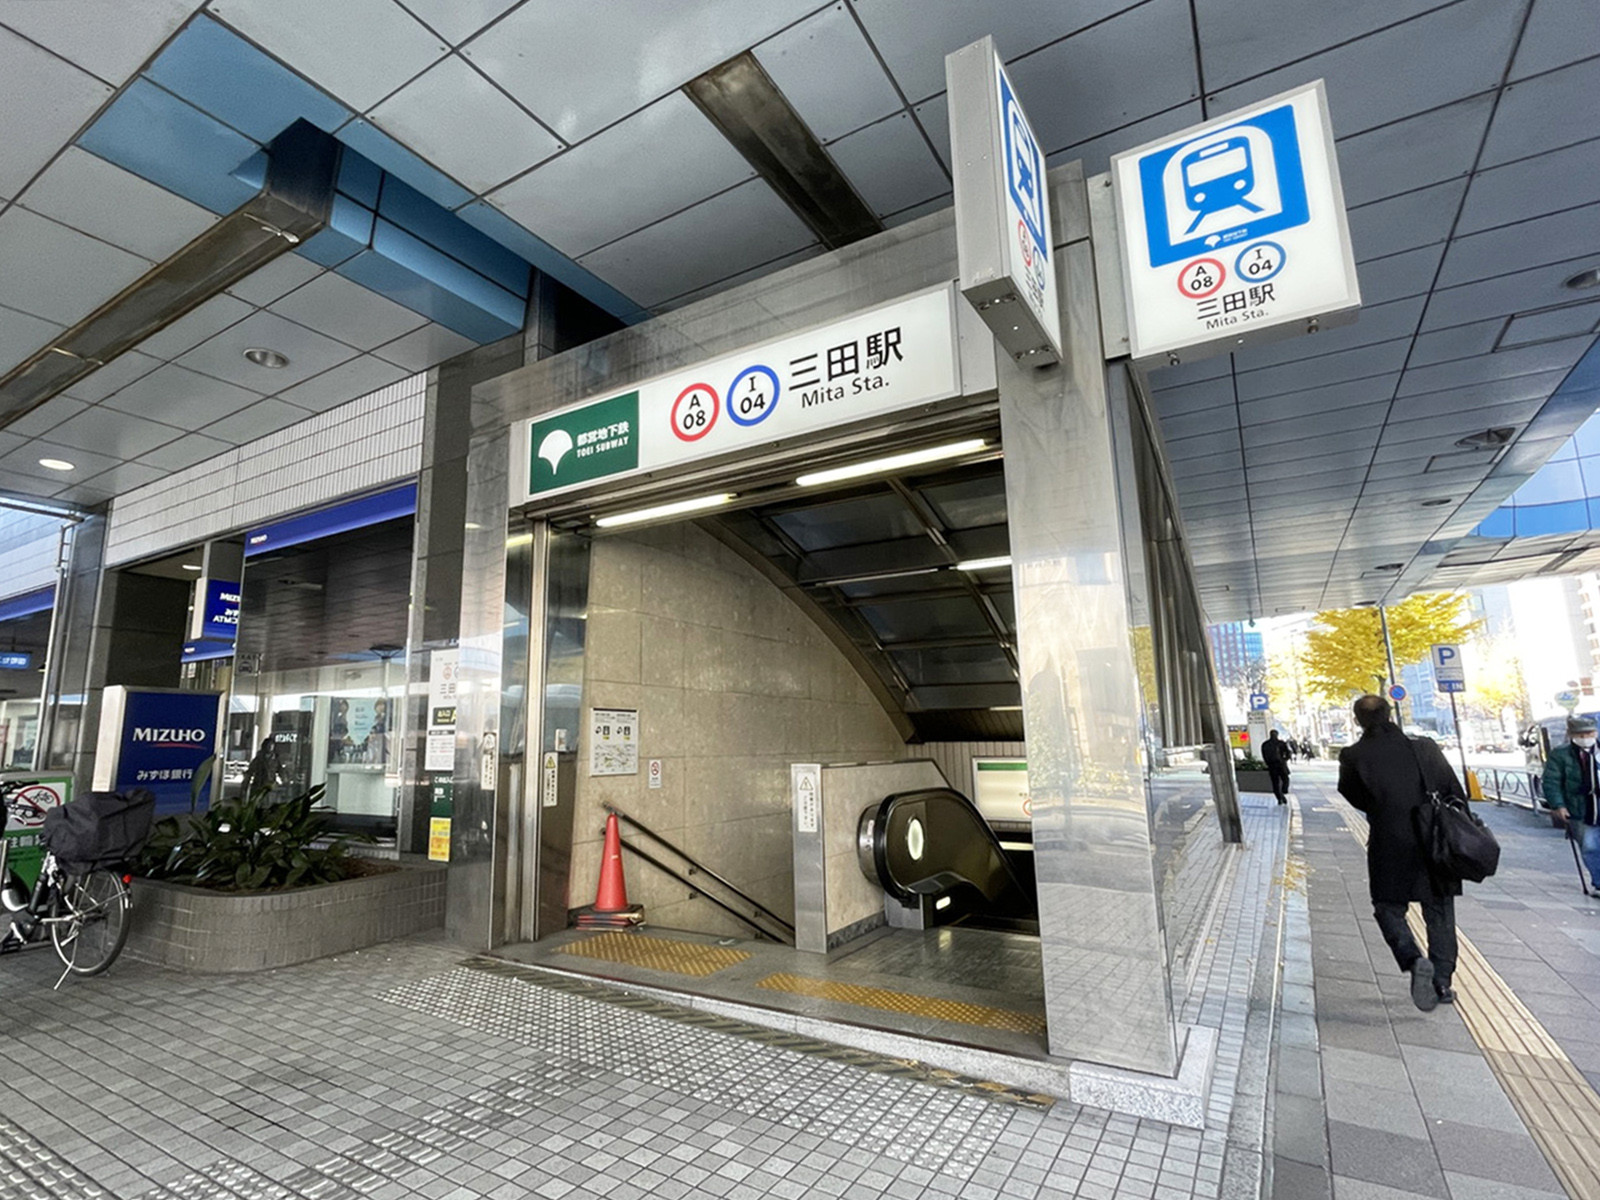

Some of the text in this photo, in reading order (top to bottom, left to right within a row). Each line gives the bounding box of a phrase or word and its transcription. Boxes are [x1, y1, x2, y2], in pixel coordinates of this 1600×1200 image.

[1256, 248, 1263, 260] I
[1195, 265, 1207, 277] A
[1248, 259, 1273, 275] 04
[1190, 276, 1214, 291] 08
[1196, 283, 1276, 320] 三田駅
[1206, 309, 1269, 330] Mita Sta.
[788, 326, 904, 391] 三田駅
[749, 376, 756, 392] I
[801, 375, 890, 408] Mita Sta.
[689, 394, 701, 410] A
[740, 393, 766, 414] 04
[683, 410, 706, 430] 08
[1438, 647, 1455, 666] P
[1252, 696, 1267, 709] P
[133, 727, 206, 742] MIZUHO
[136, 769, 193, 781] みずほ銀行
